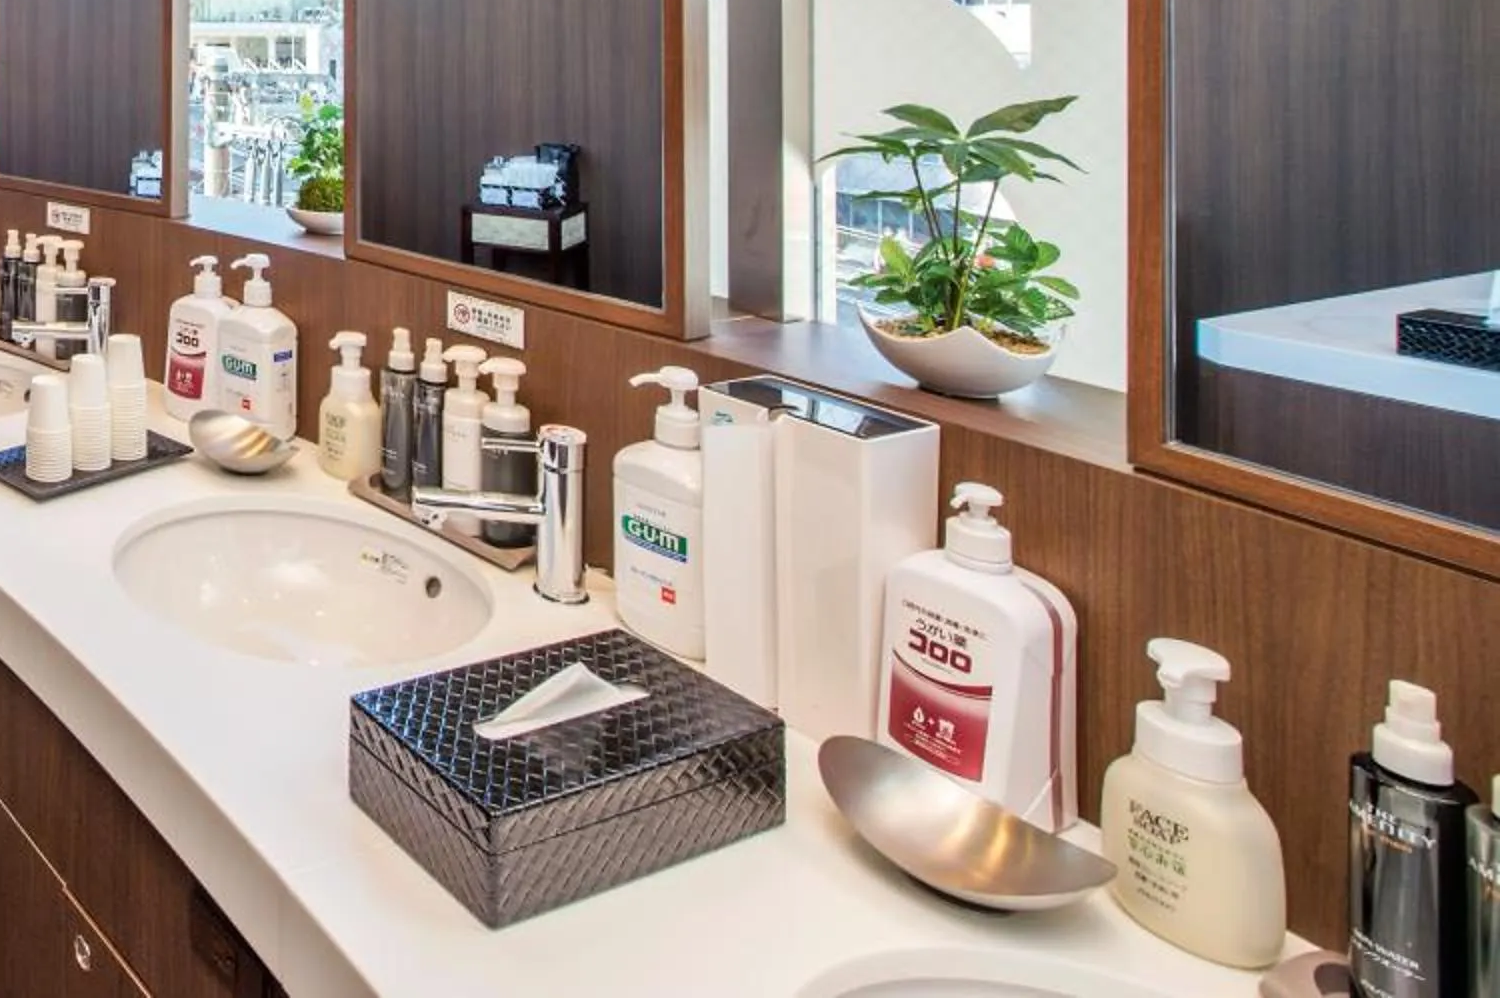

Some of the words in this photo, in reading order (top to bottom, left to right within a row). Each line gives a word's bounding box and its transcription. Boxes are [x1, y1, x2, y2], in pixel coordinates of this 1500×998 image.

[908, 626, 973, 675] コロロ
[1128, 798, 1190, 841] FACE
